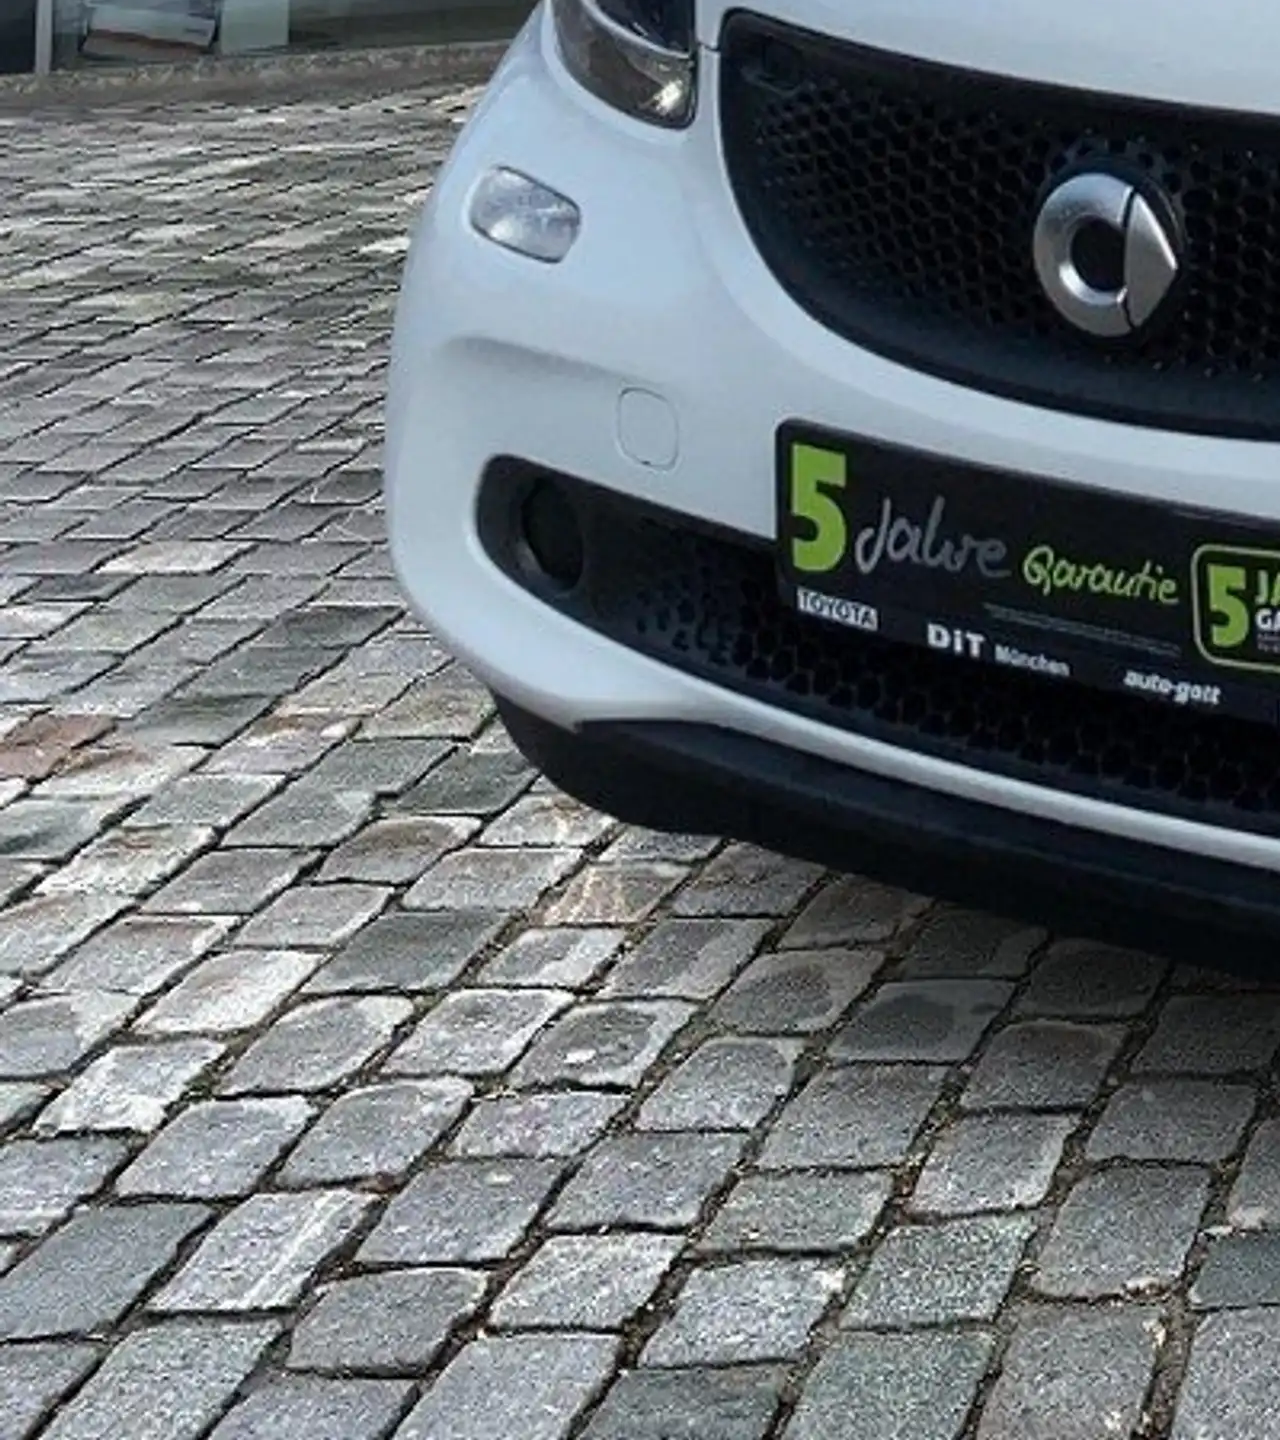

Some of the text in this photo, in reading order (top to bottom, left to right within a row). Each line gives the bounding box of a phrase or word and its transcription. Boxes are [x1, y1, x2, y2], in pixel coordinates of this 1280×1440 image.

[791, 443, 846, 573] 5
[798, 587, 878, 630] TOYOTA
[1208, 564, 1249, 647] 5
